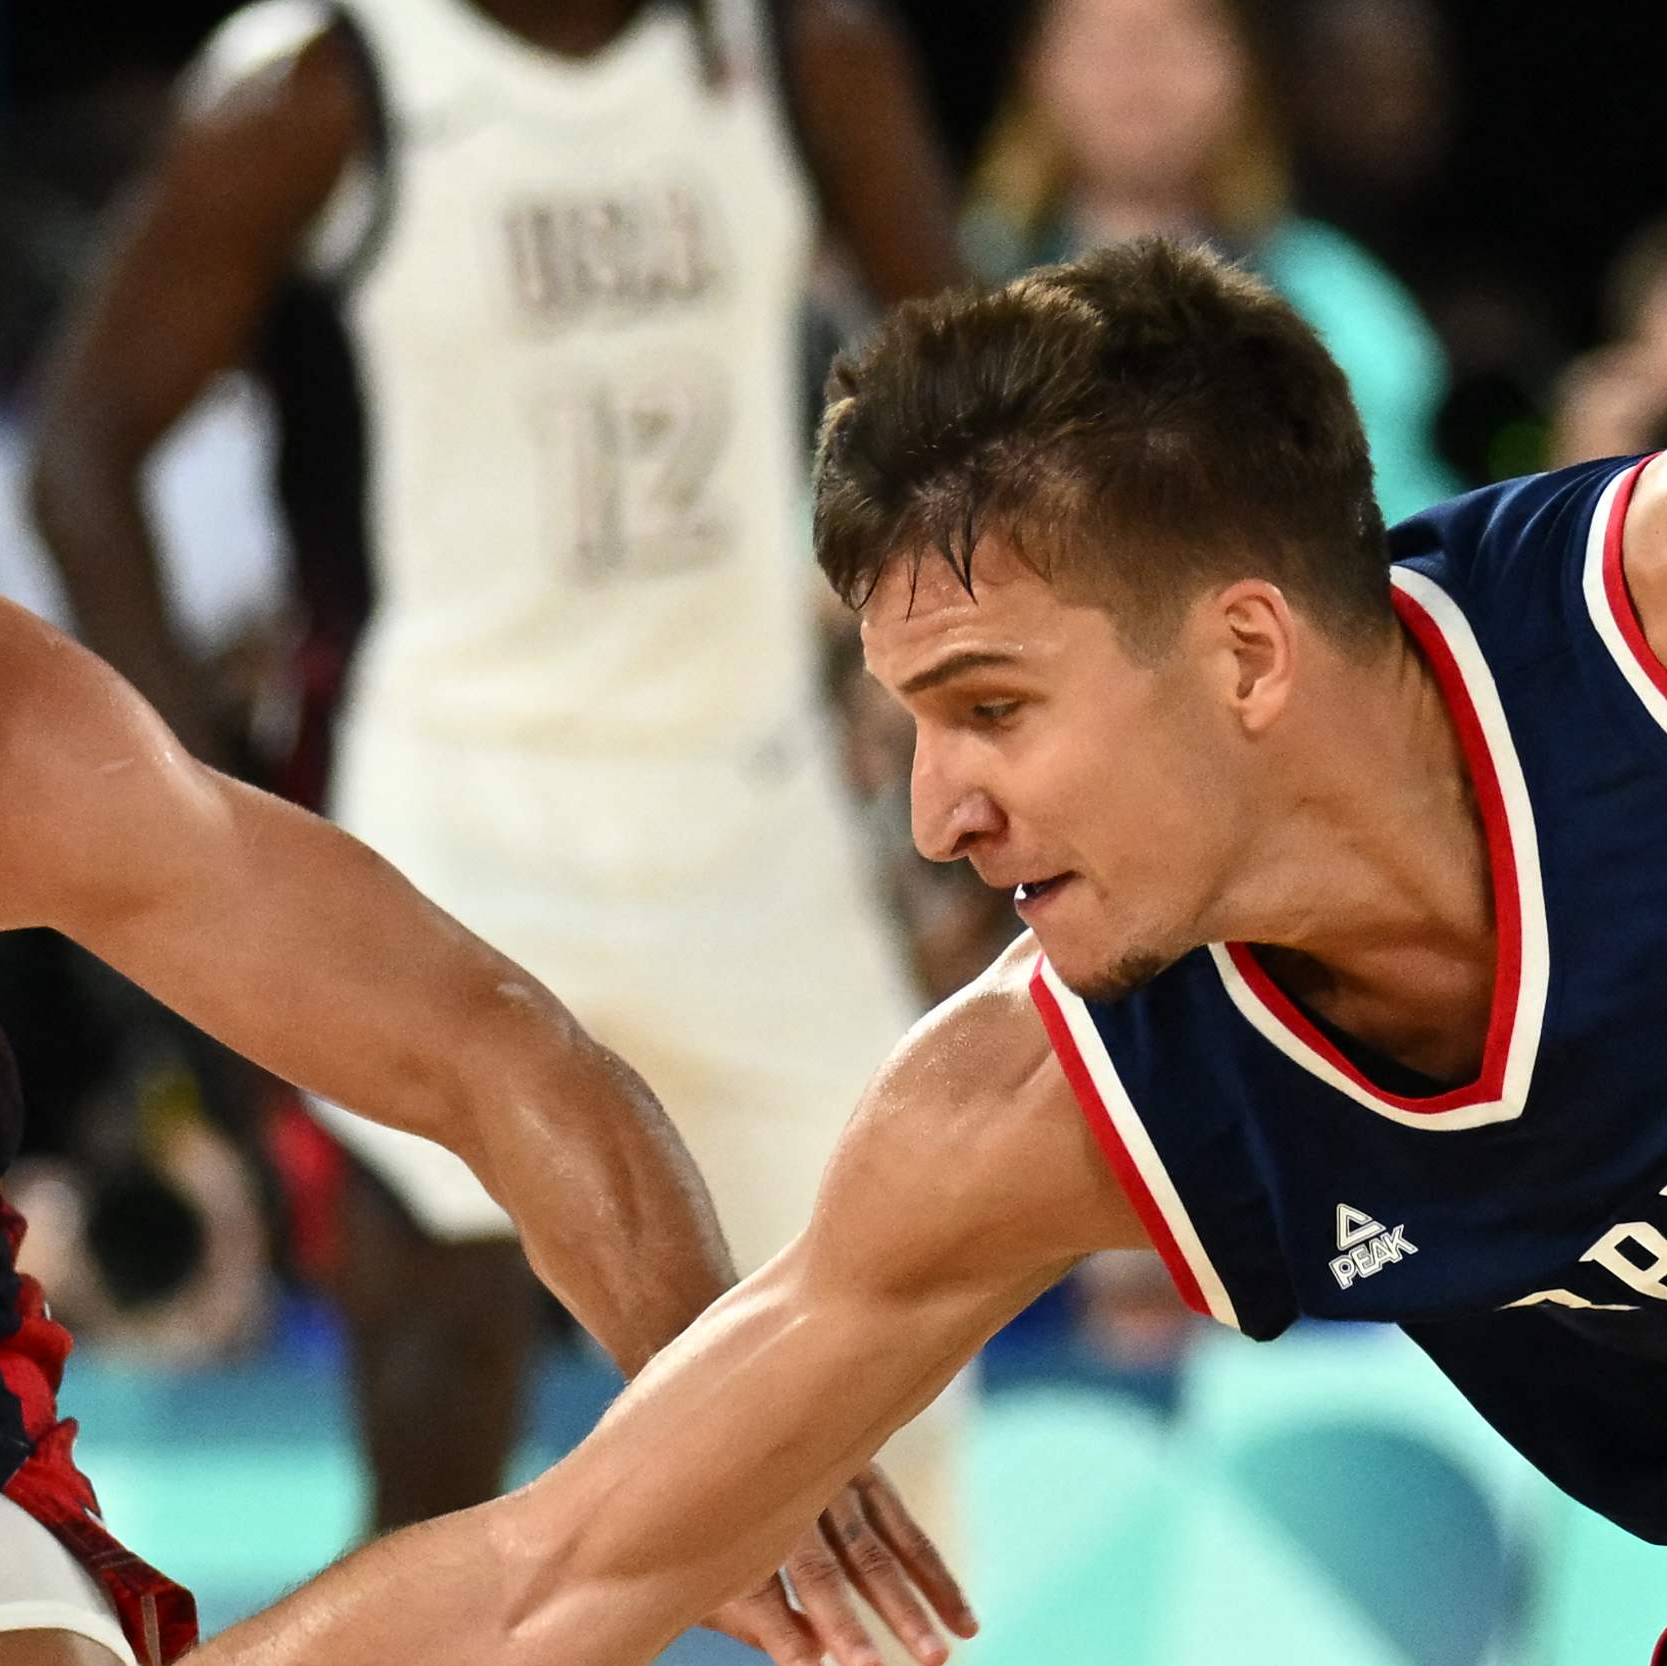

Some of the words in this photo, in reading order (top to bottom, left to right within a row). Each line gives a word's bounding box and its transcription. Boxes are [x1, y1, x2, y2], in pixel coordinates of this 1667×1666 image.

[500, 190, 720, 322] USA
[546, 378, 732, 584] 12
[1328, 1223, 1419, 1290] PEAK
